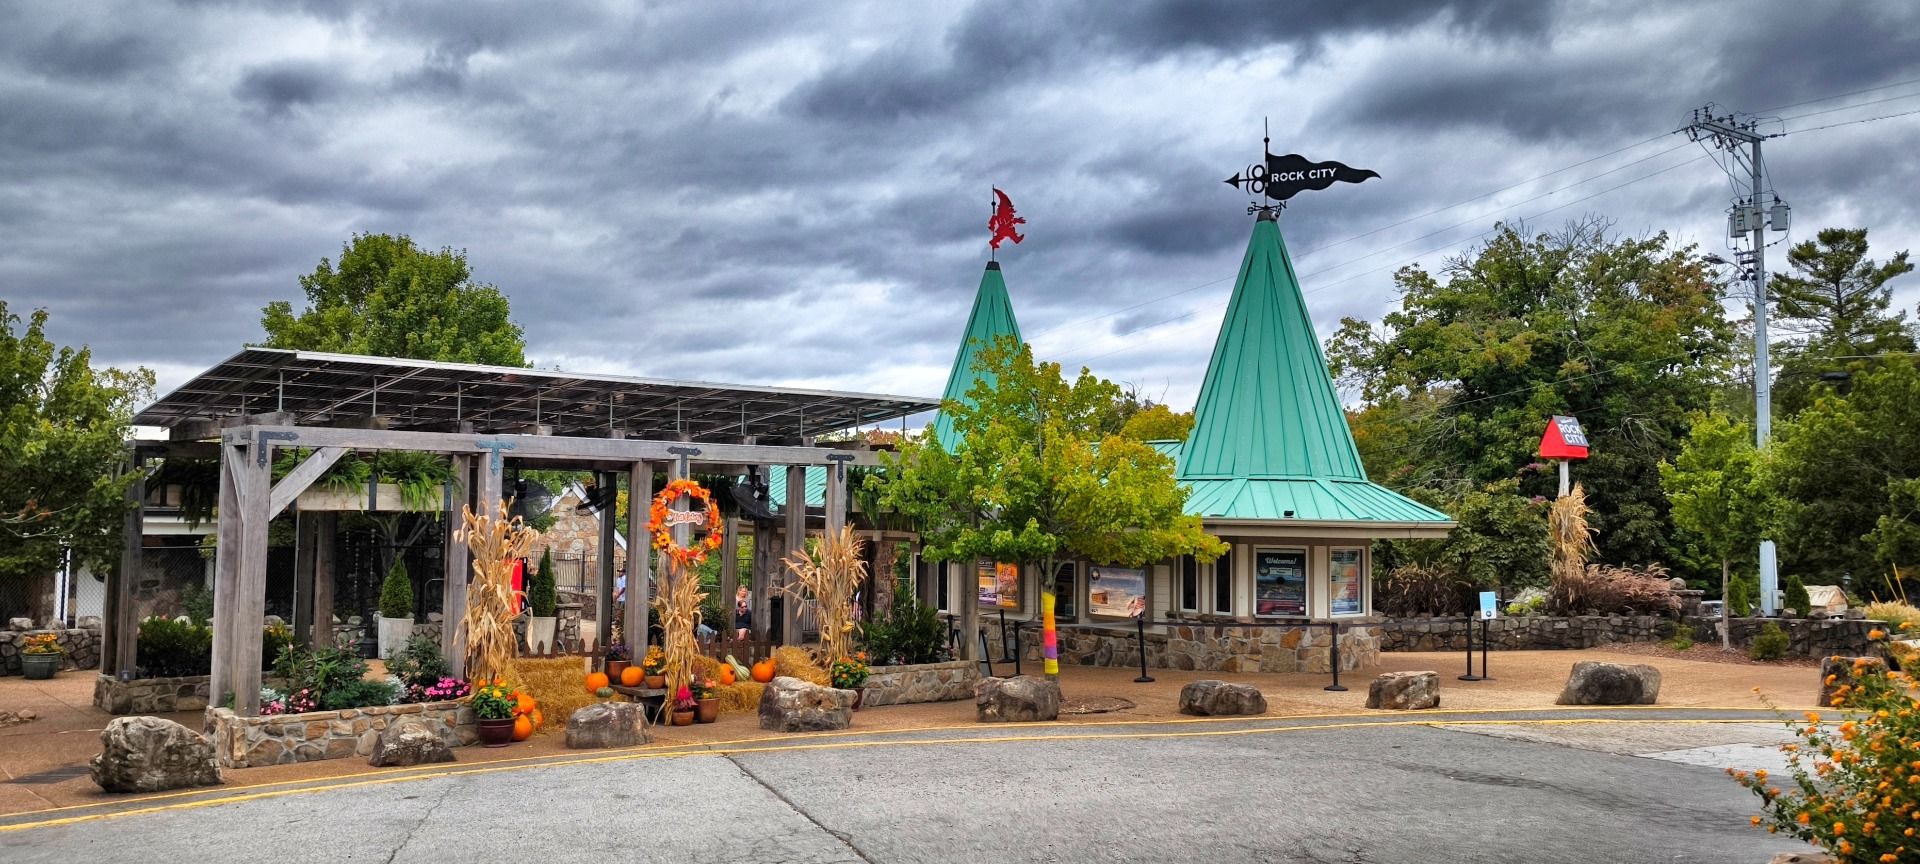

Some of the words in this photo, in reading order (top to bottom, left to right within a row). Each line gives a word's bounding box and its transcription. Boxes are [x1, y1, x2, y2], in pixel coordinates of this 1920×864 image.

[1271, 171, 1304, 183] ROCK
[1308, 168, 1337, 179] CITY
[1558, 424, 1583, 434] ROCK
[1565, 434, 1584, 444] CITY
[1264, 557, 1297, 565] Welcome!
